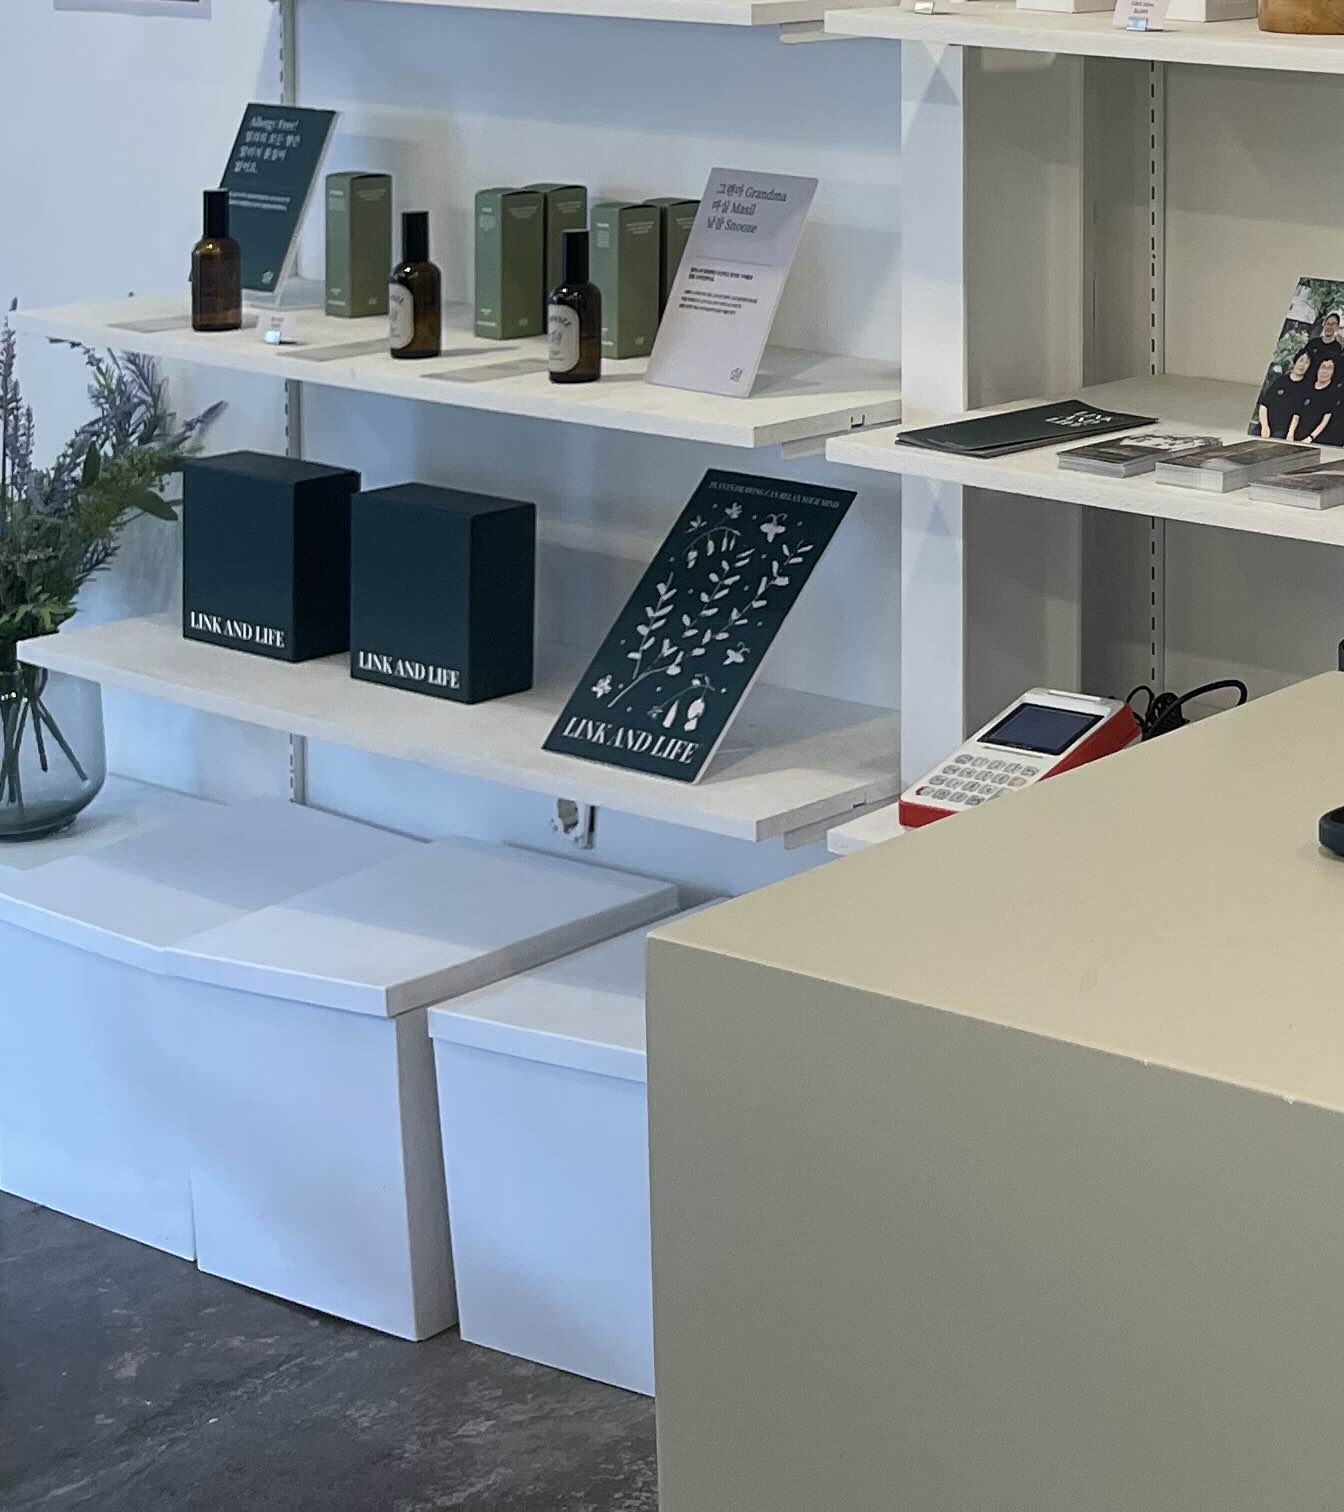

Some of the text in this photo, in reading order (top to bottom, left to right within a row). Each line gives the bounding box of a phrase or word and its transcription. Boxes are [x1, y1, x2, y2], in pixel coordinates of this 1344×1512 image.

[745, 185, 787, 202] Grandma
[190, 611, 285, 648] LINK AND LIFE
[358, 650, 460, 689] LINK AND LIFE
[562, 716, 700, 764] LINK AND LIFE
